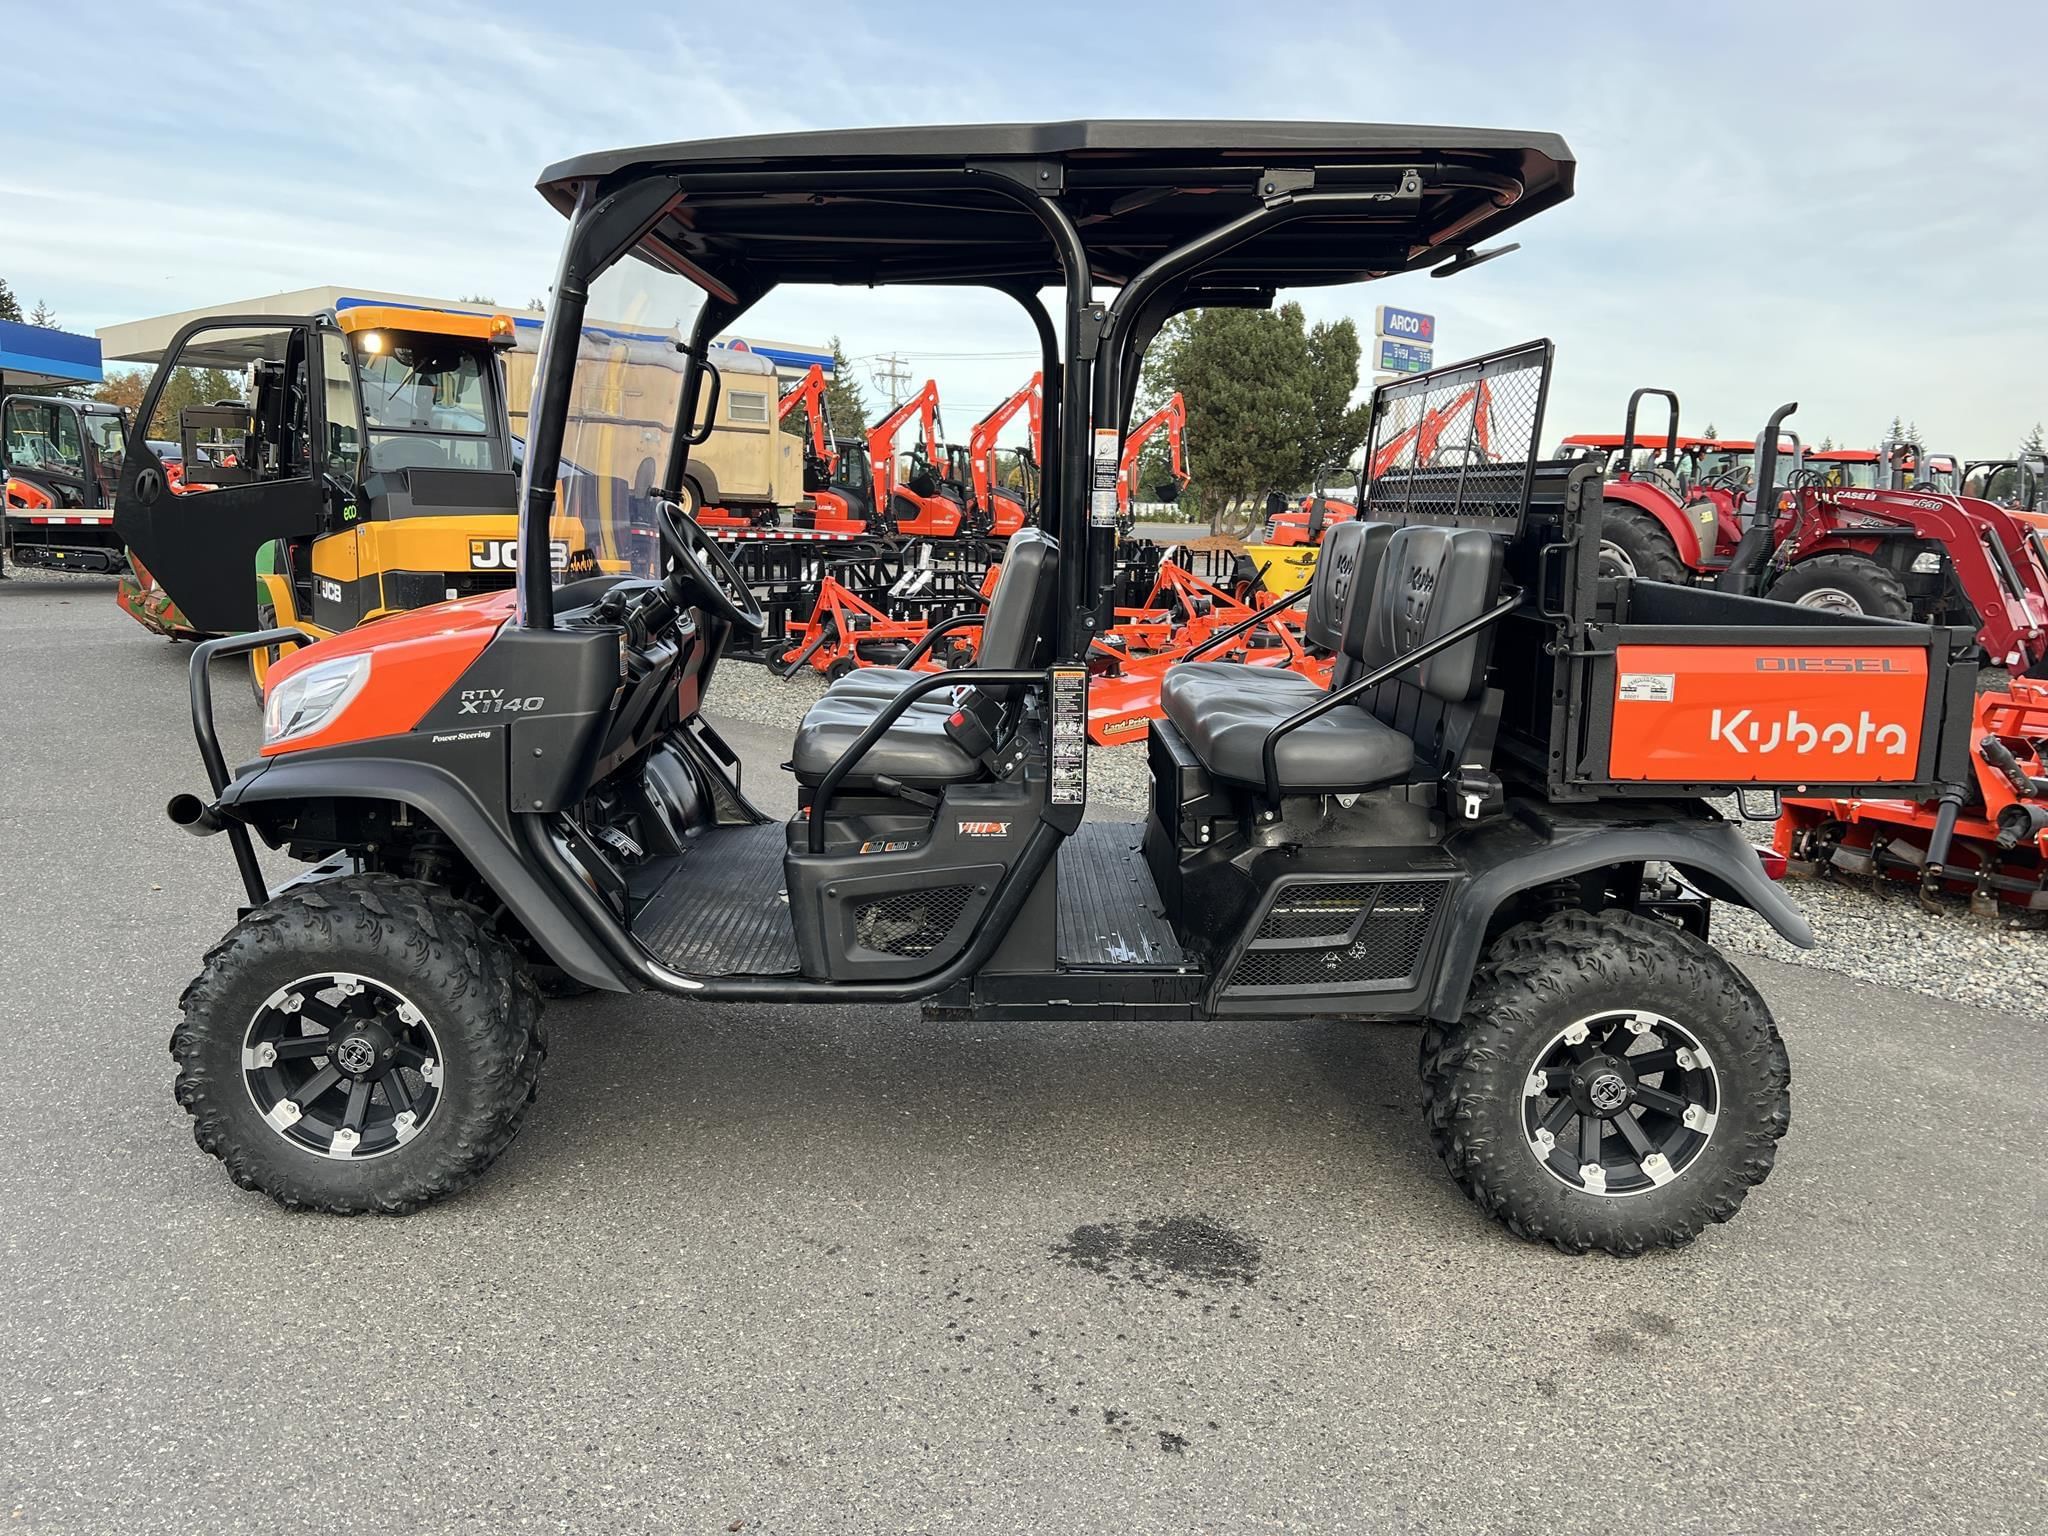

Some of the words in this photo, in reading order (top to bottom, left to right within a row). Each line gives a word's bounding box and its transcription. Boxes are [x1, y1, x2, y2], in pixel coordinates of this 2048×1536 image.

[1389, 314, 1419, 333] ARCO
[1836, 490, 1866, 500] CASE
[343, 504, 357, 521] eco
[322, 580, 342, 602] JCB
[1755, 657, 1910, 673] DIESEL
[461, 688, 505, 700] RTV
[457, 696, 545, 715] X1140
[1103, 720, 1126, 732] Land
[1710, 709, 1907, 755] Kubota
[432, 734, 457, 743] Power
[457, 730, 491, 741] Steering
